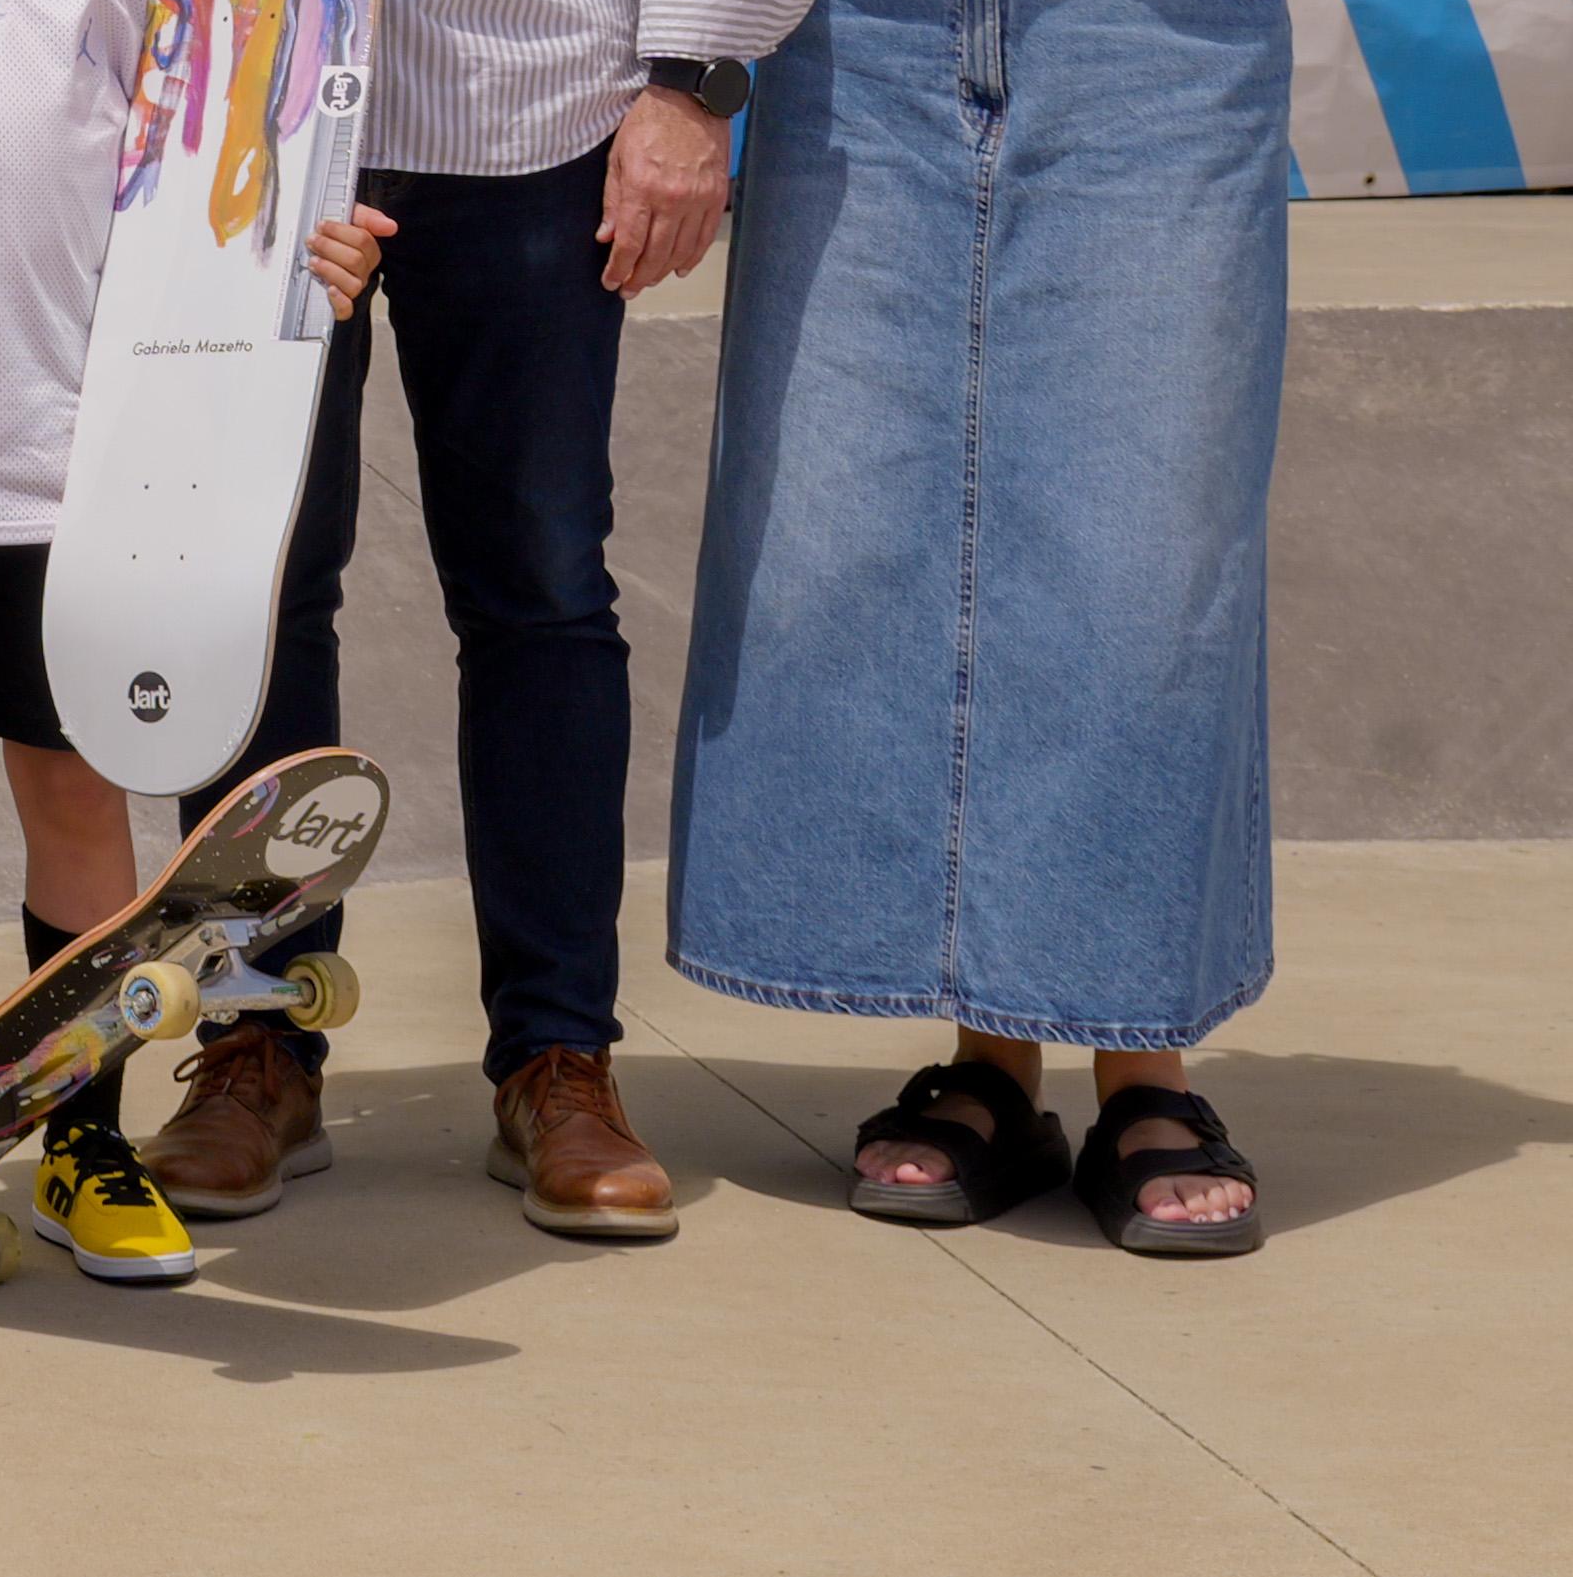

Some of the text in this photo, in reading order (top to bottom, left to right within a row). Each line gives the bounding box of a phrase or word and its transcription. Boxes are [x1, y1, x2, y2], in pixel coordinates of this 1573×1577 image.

[325, 69, 354, 112] Jart
[132, 339, 254, 357] Gabriela Mazetto
[129, 683, 171, 710] Jart
[275, 798, 367, 856] Jart
